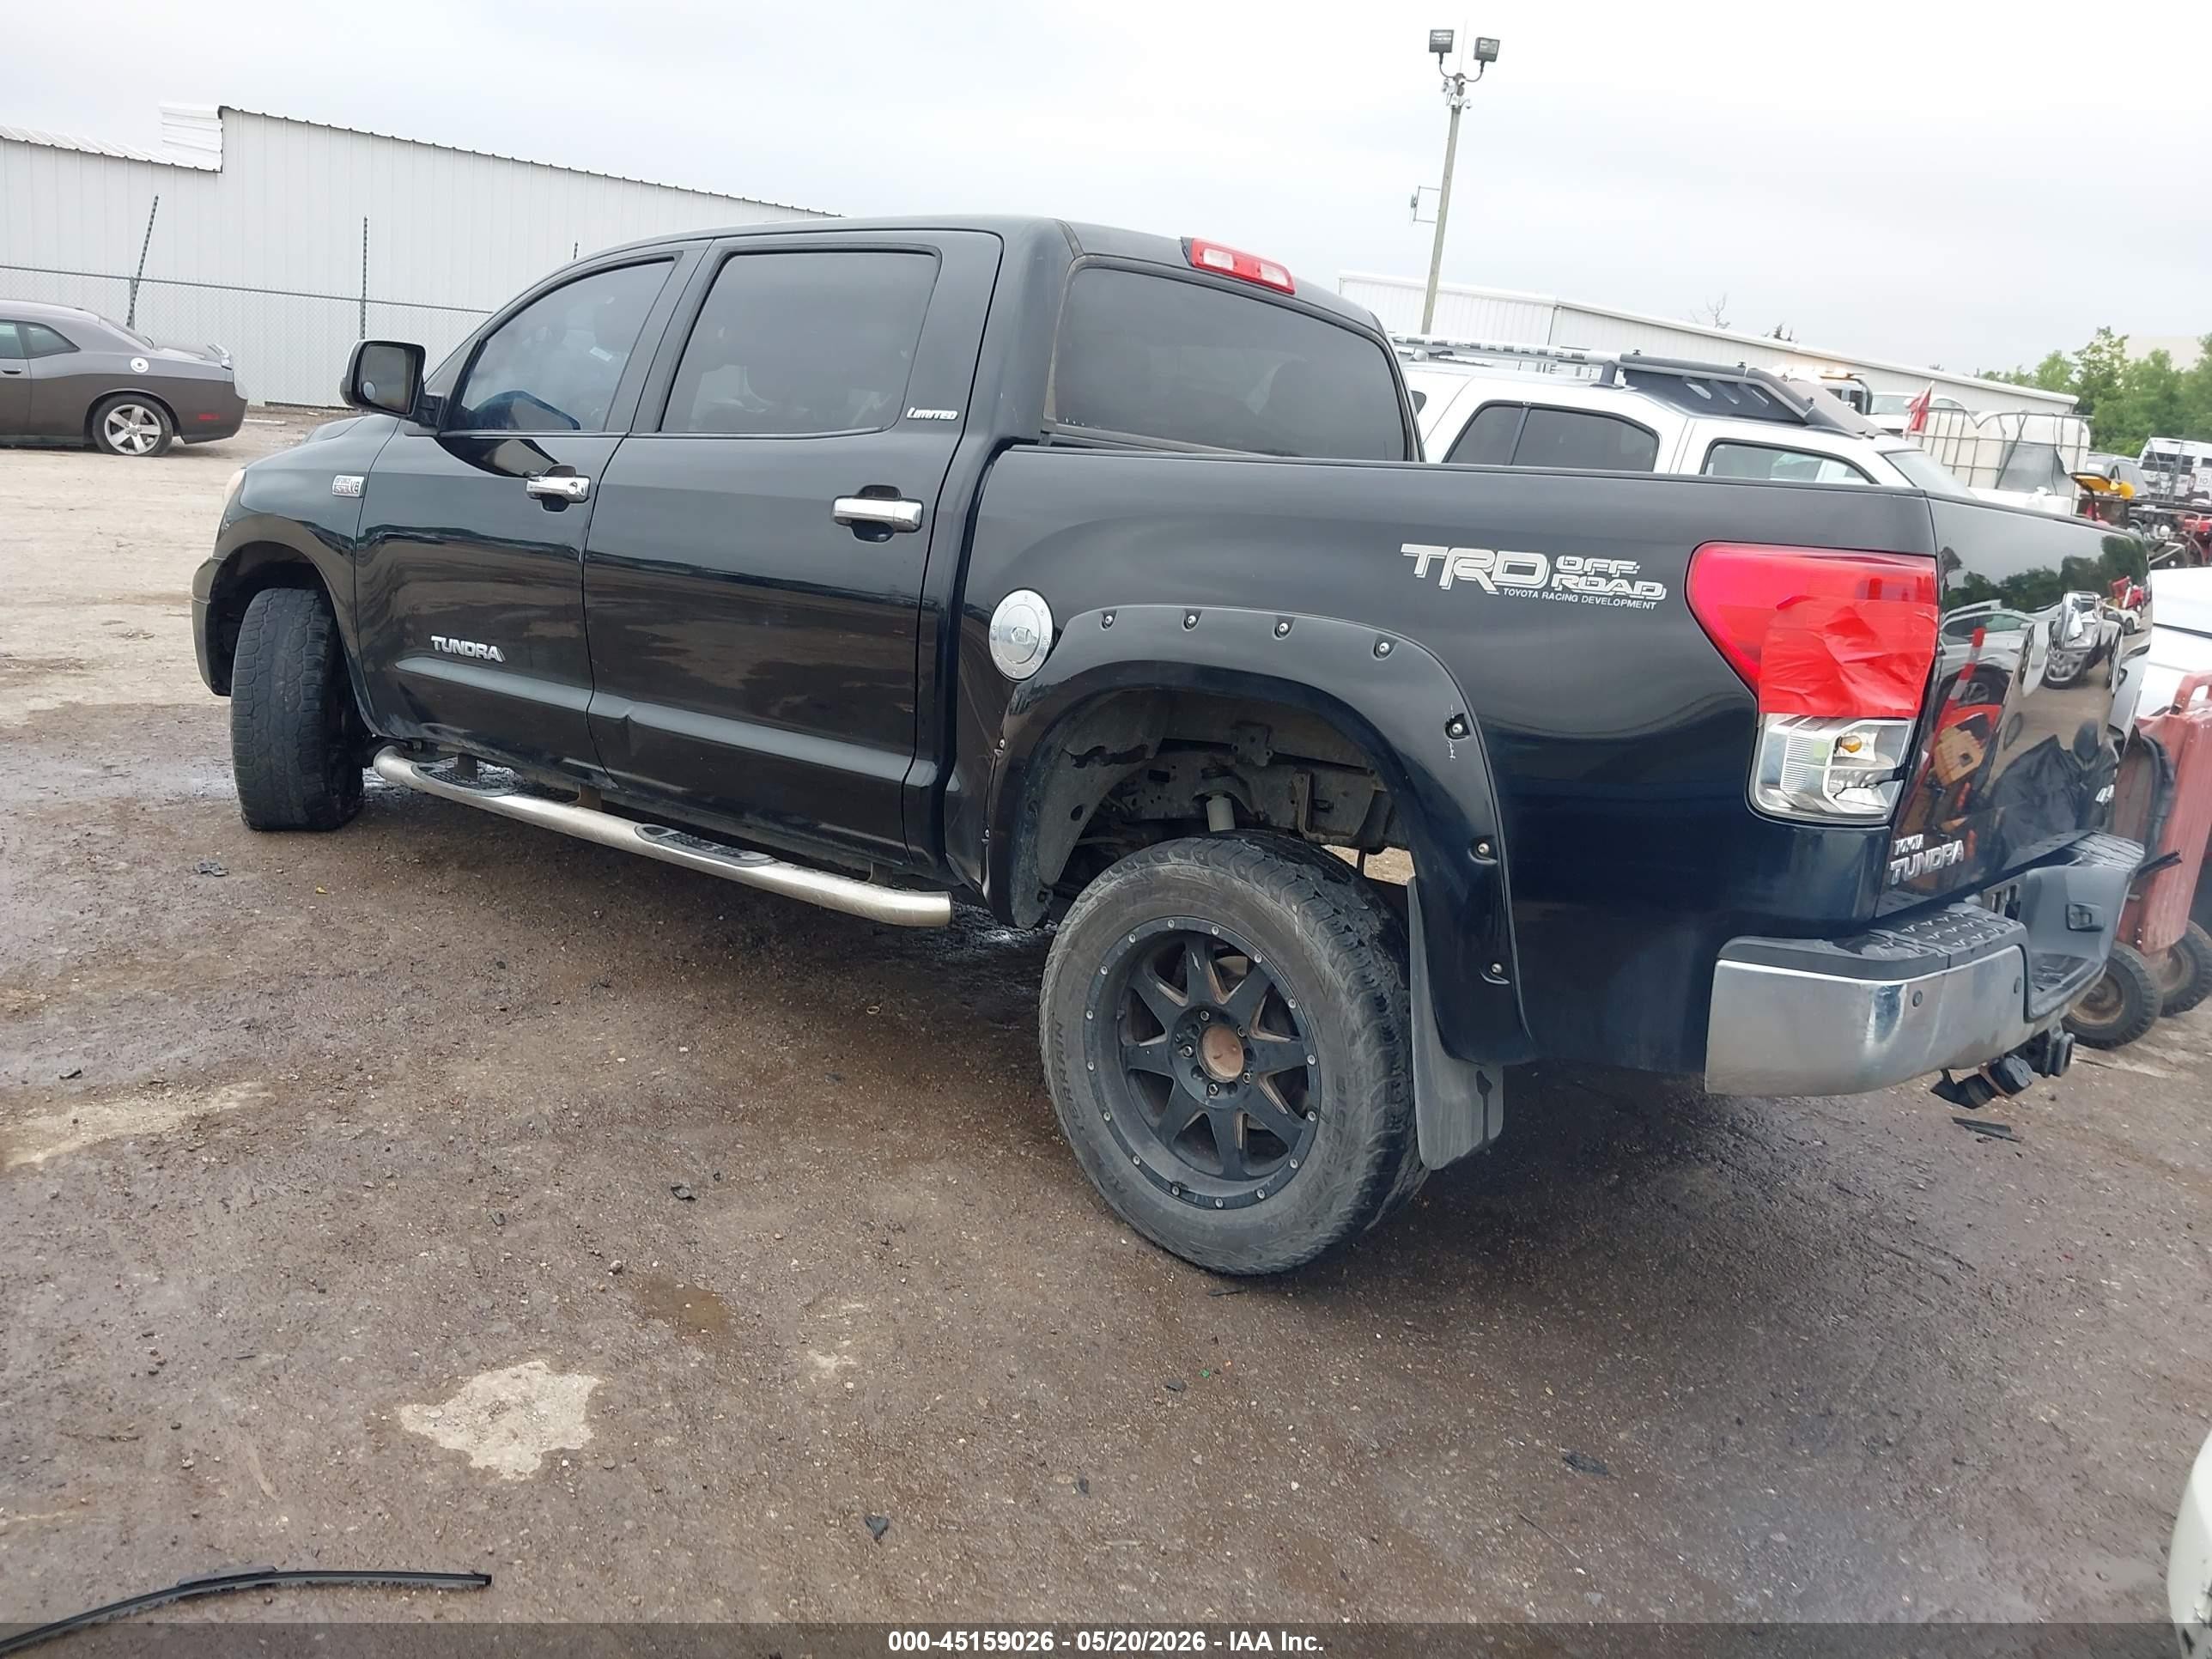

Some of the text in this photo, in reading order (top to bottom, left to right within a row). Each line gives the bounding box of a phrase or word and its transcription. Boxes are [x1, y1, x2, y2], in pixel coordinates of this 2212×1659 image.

[1401, 543, 1551, 595] TRD
[1503, 587, 1658, 611] TOYOTA RACING DEVELOPMENT
[1550, 573, 1667, 600] ROAD
[430, 635, 506, 663] TUNDRA
[1889, 839, 1965, 886] TUNDRA
